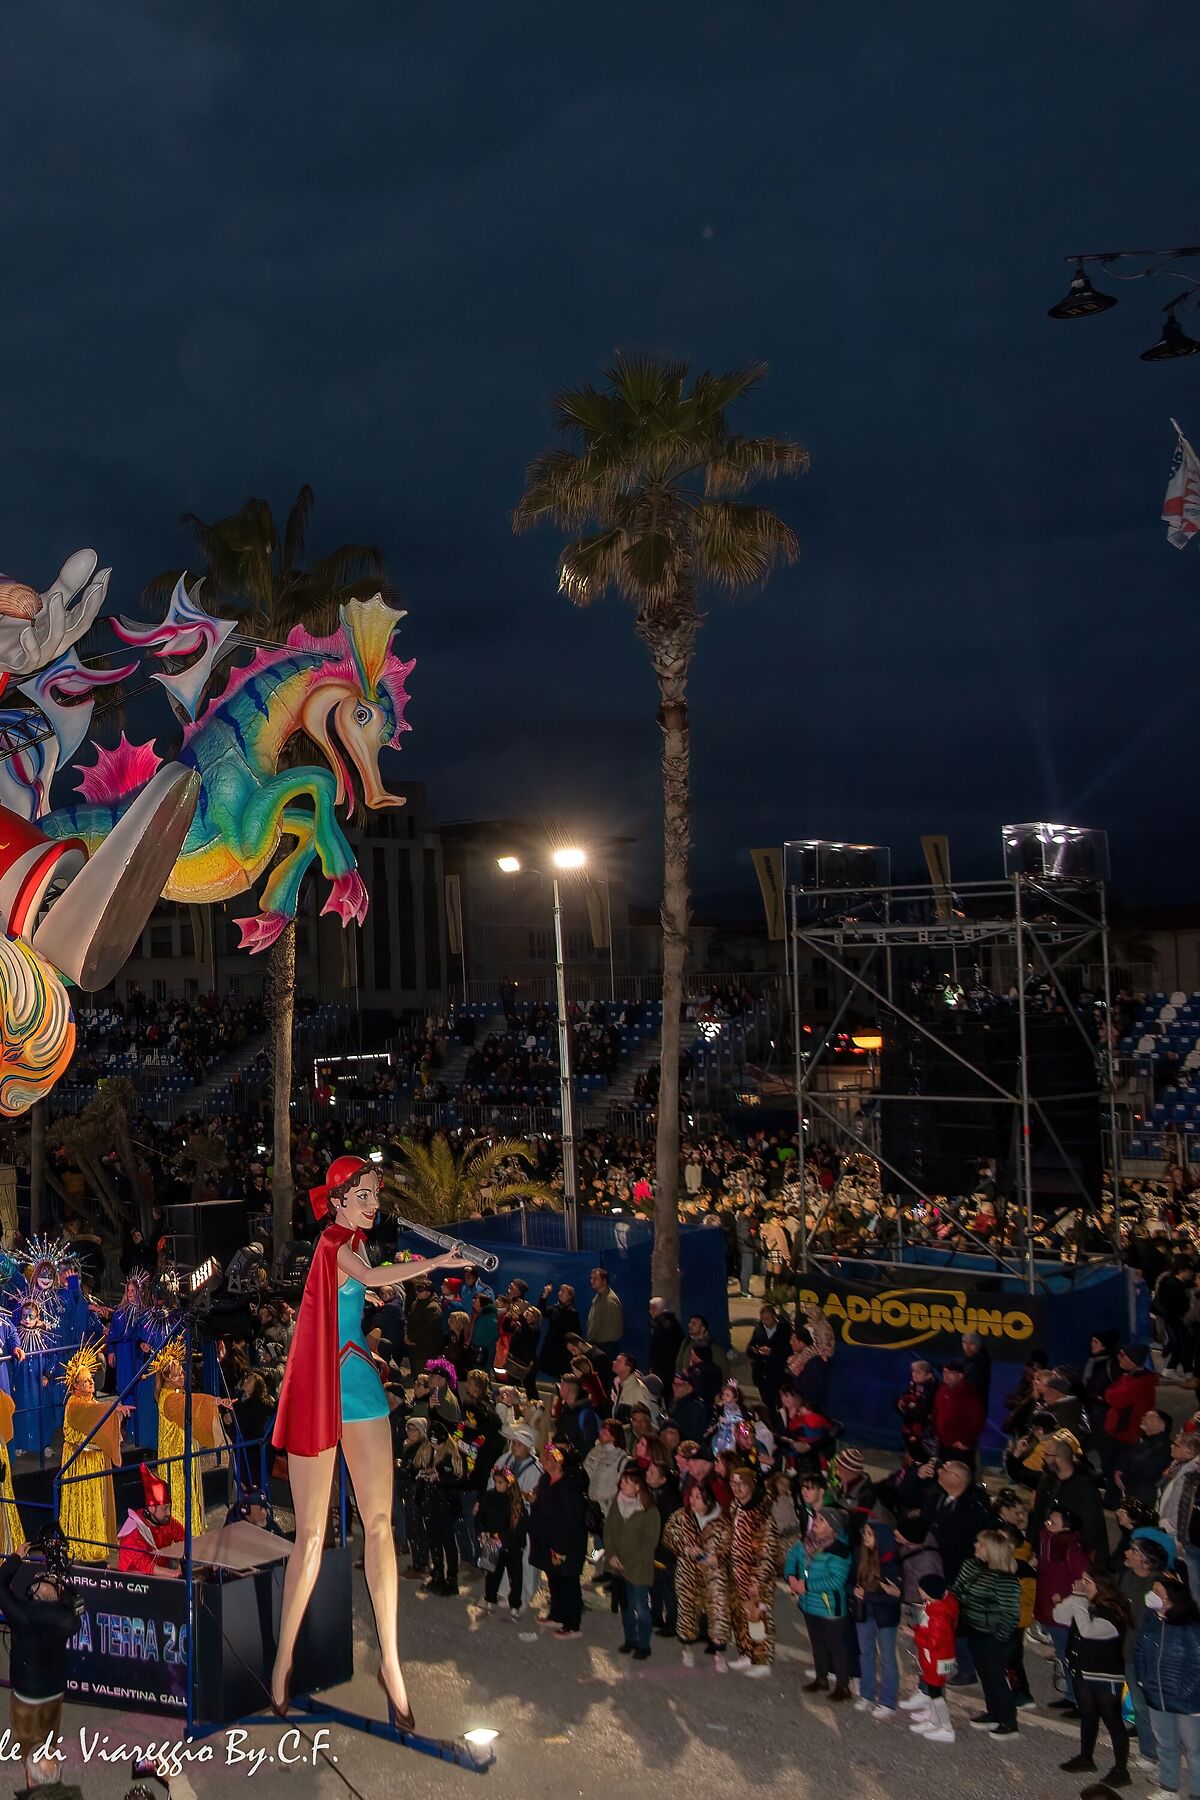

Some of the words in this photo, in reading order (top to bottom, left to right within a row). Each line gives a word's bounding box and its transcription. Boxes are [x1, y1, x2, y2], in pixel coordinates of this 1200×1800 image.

[799, 1288, 1035, 1341] RADIOBRUNO
[126, 1582, 150, 1594] CAT
[96, 1611, 160, 1661] TERRA
[81, 1681, 90, 1692] E
[92, 1683, 157, 1703] VALENTINA
[159, 1694, 188, 1707] GALL
